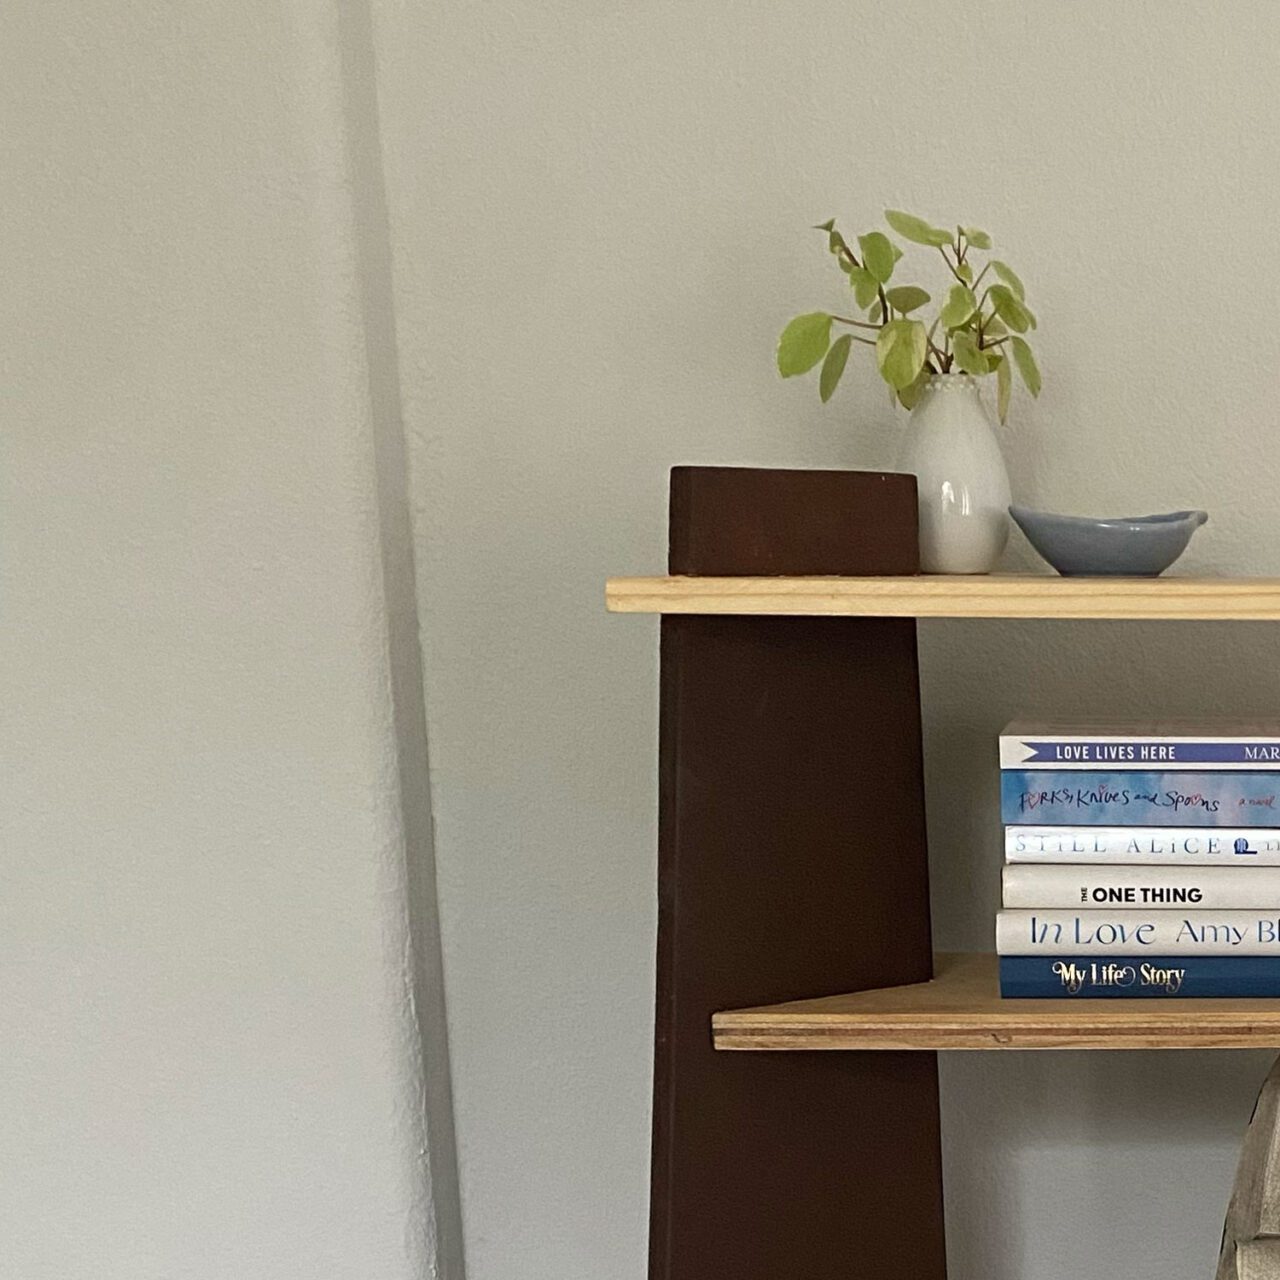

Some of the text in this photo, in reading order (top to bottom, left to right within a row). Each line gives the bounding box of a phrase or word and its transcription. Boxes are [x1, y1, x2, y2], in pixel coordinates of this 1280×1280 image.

[1056, 746, 1176, 759] LOVE LIVES HERE
[1092, 887, 1136, 903] ONE
[1140, 887, 1203, 903] THING
[1031, 917, 1156, 945] In Love
[1176, 919, 1248, 945] Amy
[1052, 961, 1185, 994] My Life Story
